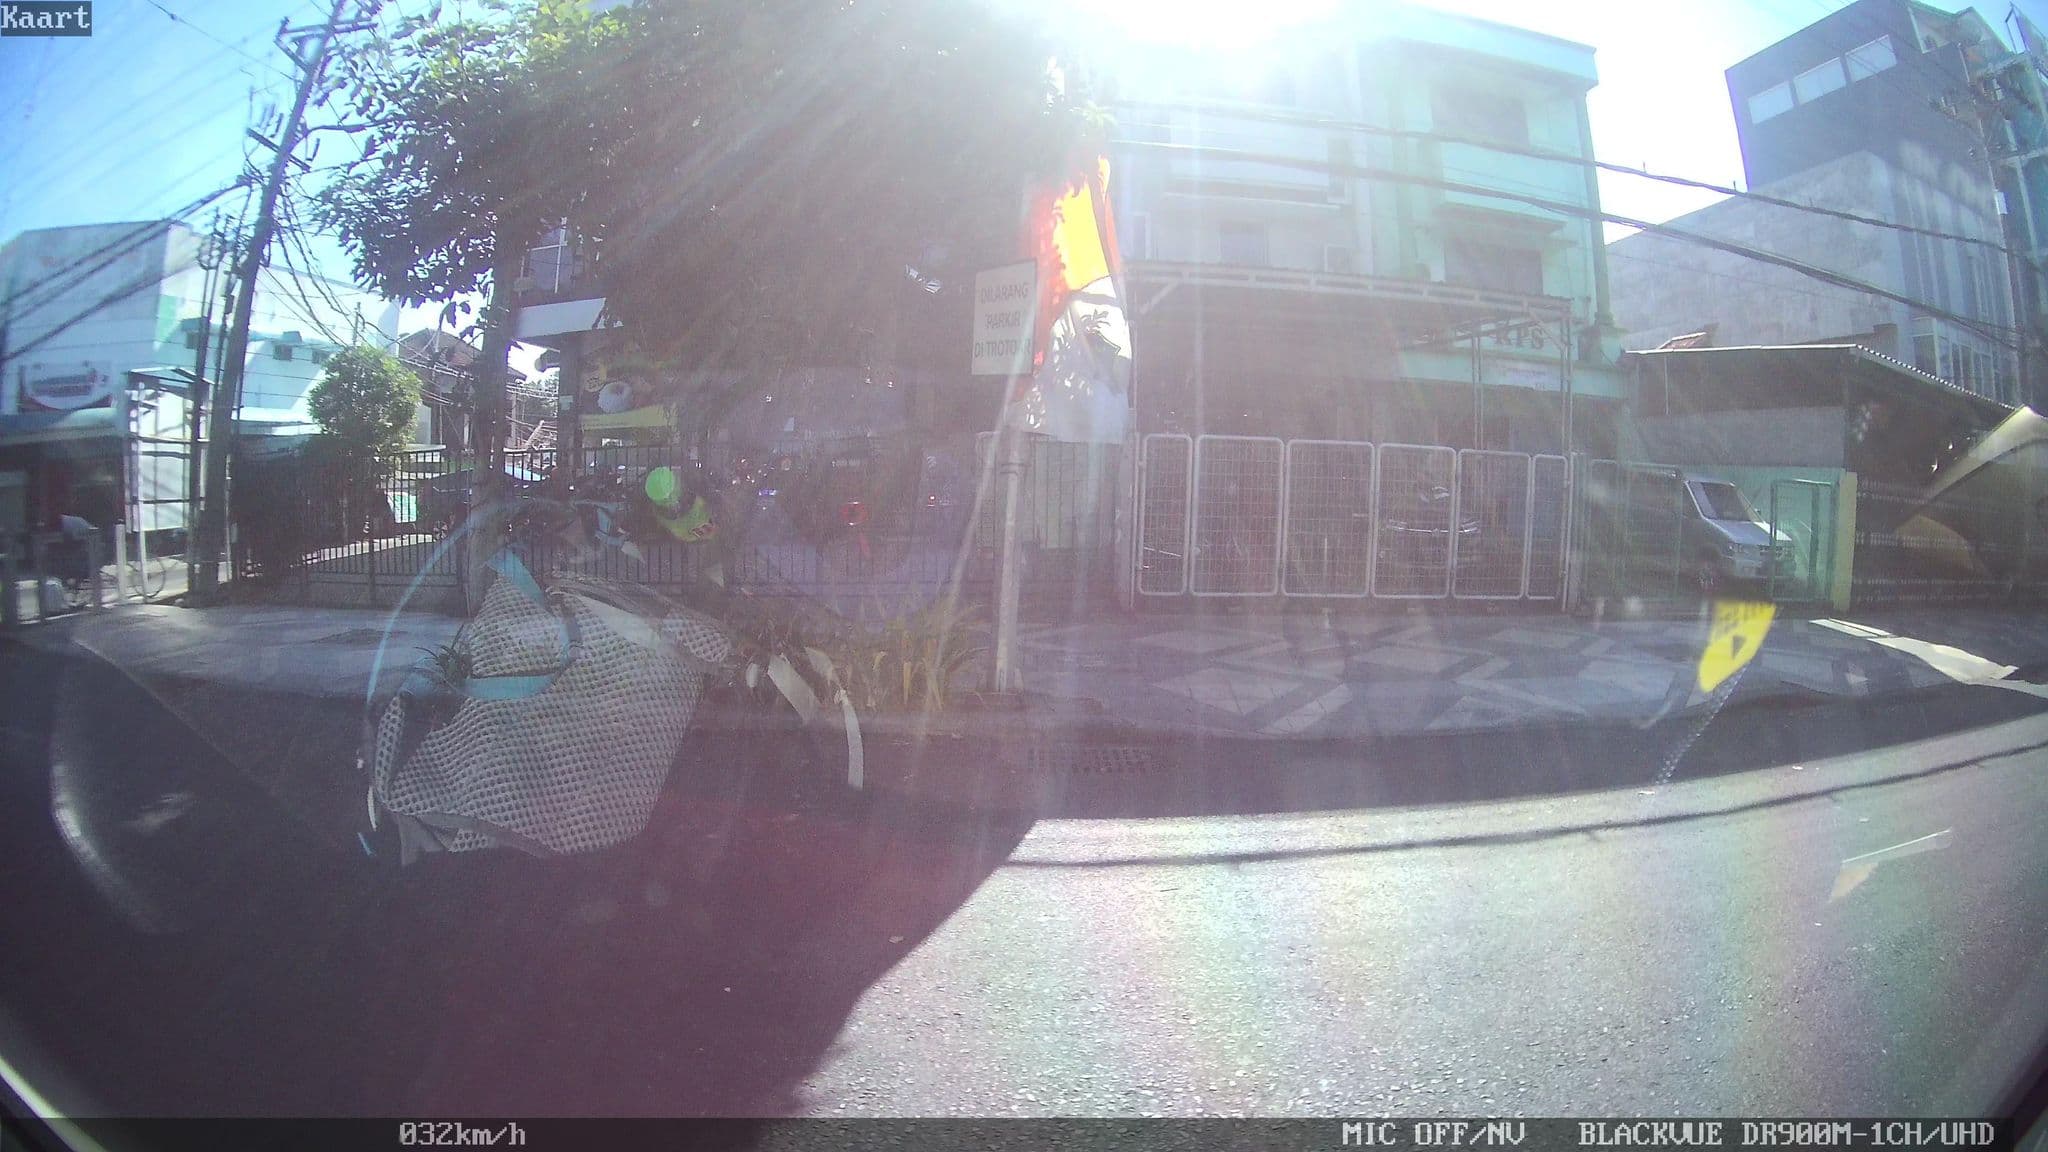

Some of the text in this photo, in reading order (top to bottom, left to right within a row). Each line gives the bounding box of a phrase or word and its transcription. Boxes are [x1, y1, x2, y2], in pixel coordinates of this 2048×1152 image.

[980, 282, 1030, 303] DILARANG
[984, 310, 1022, 329] PARKIR
[974, 338, 1032, 358] DI TROTOR
